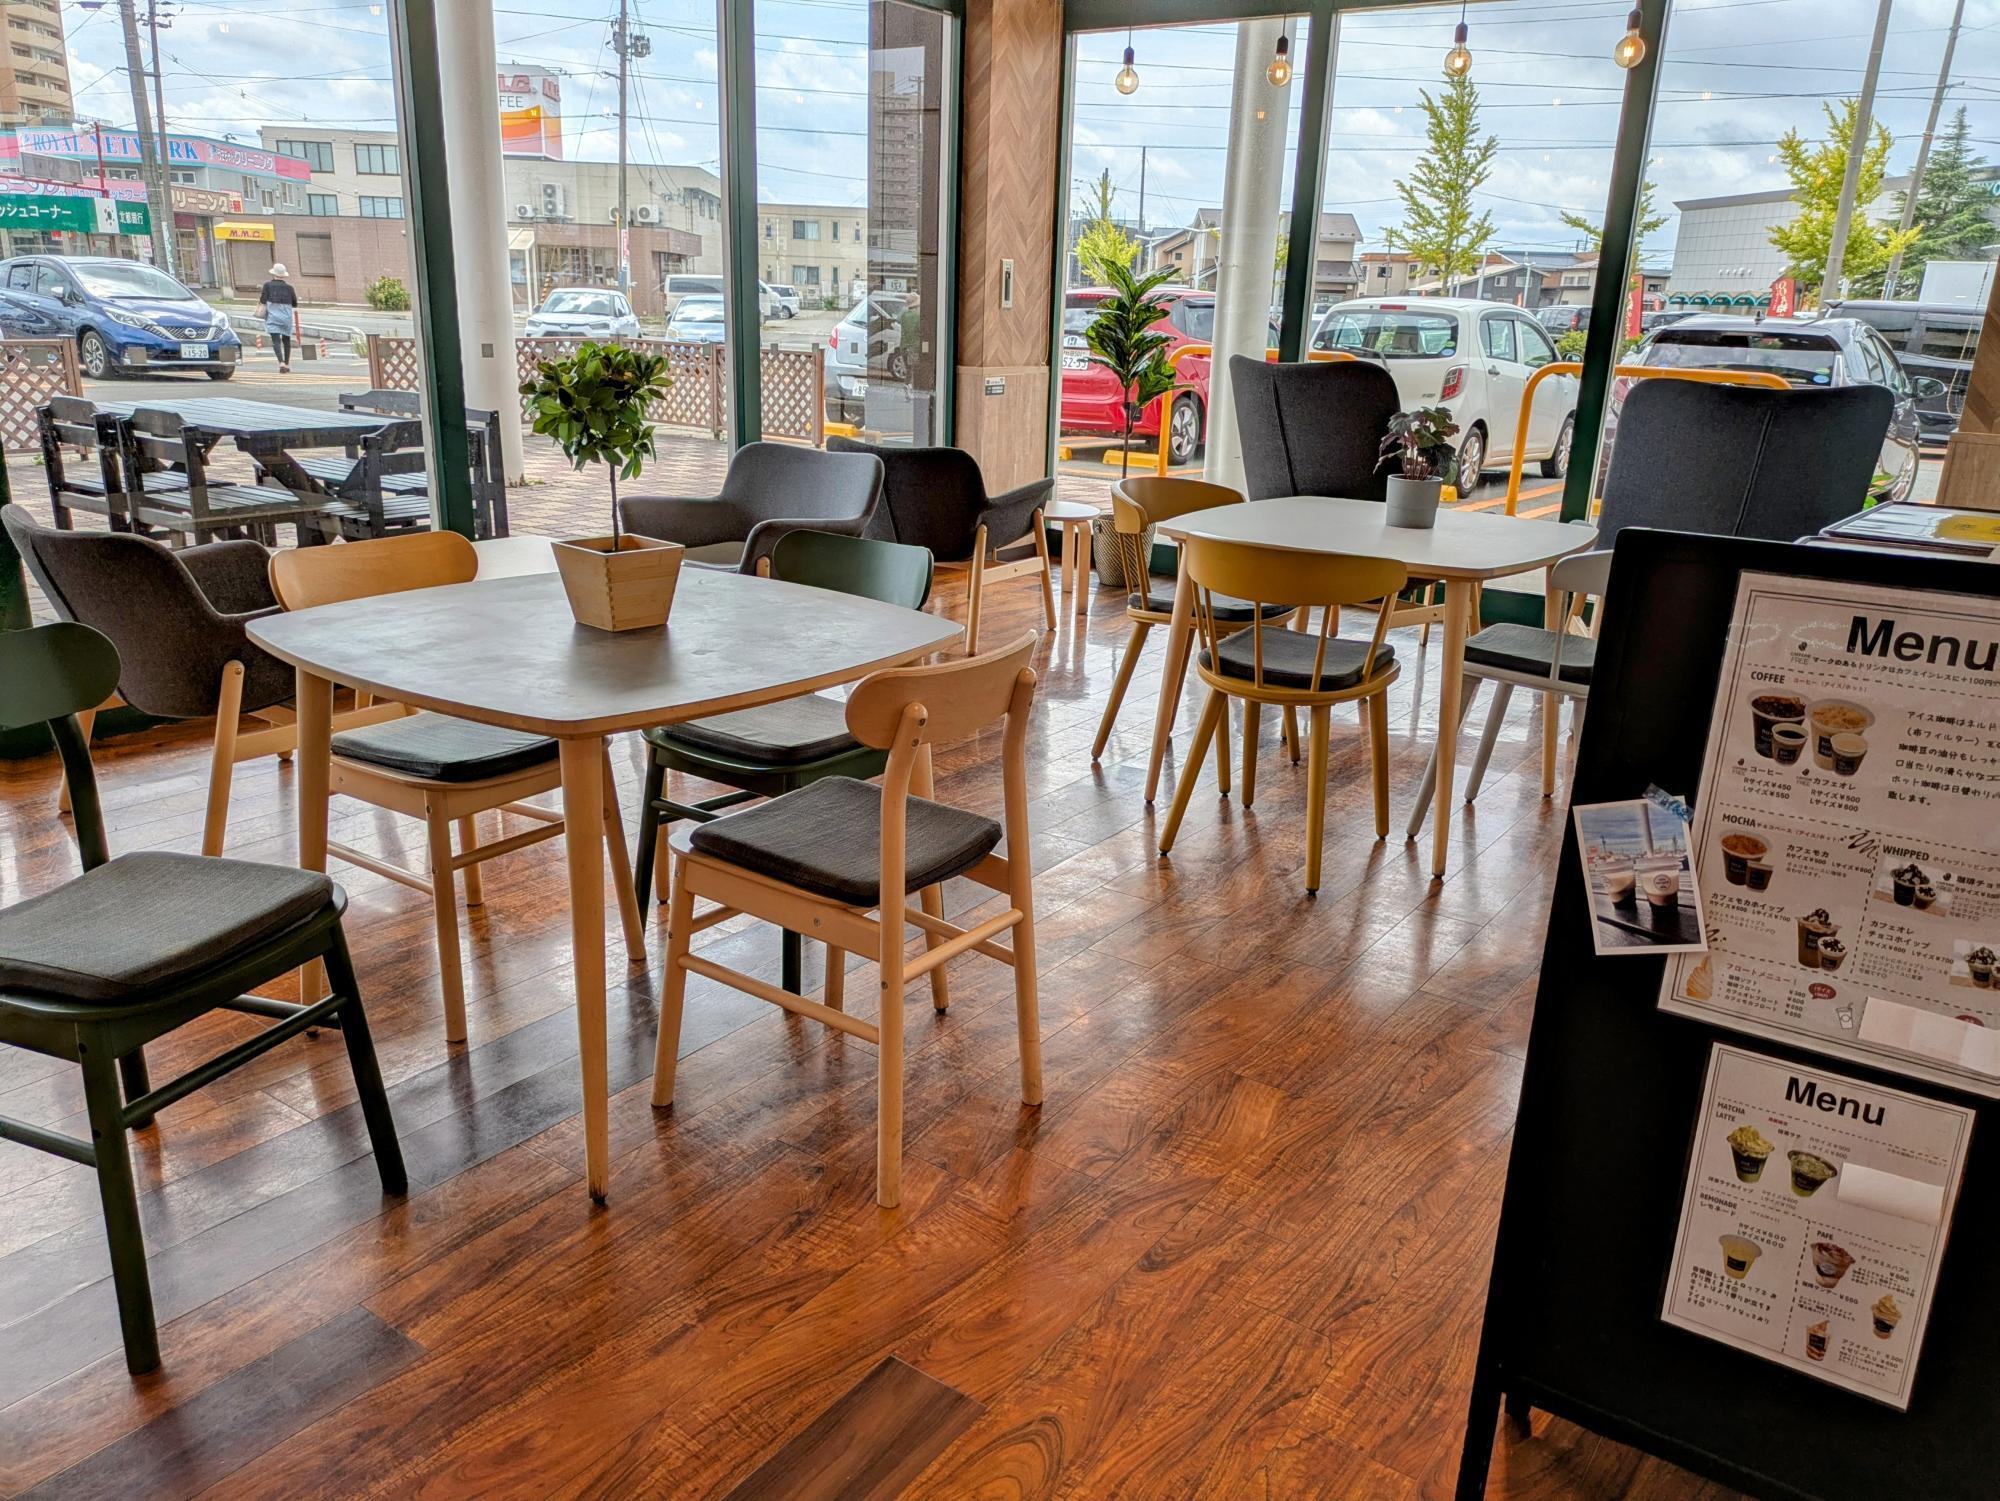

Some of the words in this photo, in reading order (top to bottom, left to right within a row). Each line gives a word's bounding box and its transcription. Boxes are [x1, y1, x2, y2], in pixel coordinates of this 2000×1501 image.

[33, 133, 84, 152] ROYAL
[1846, 615, 2000, 672] Menu
[1750, 671, 1785, 684] COFFEE
[1750, 766, 1783, 776] コーヒー
[1812, 777, 1857, 791] カフェオレ
[1722, 813, 1756, 828] MOCHA
[1787, 844, 1829, 858] カフェモカ
[1882, 844, 1930, 861] WHIPPED
[1870, 920, 1915, 935] カフェオレ
[1868, 929, 1931, 949] チョコホイップ
[1717, 1102, 1745, 1115] MATCHA
[1785, 1076, 1886, 1127] Menu
[1715, 1111, 1736, 1122] LATTE
[1700, 1201, 1736, 1216] レモネード
